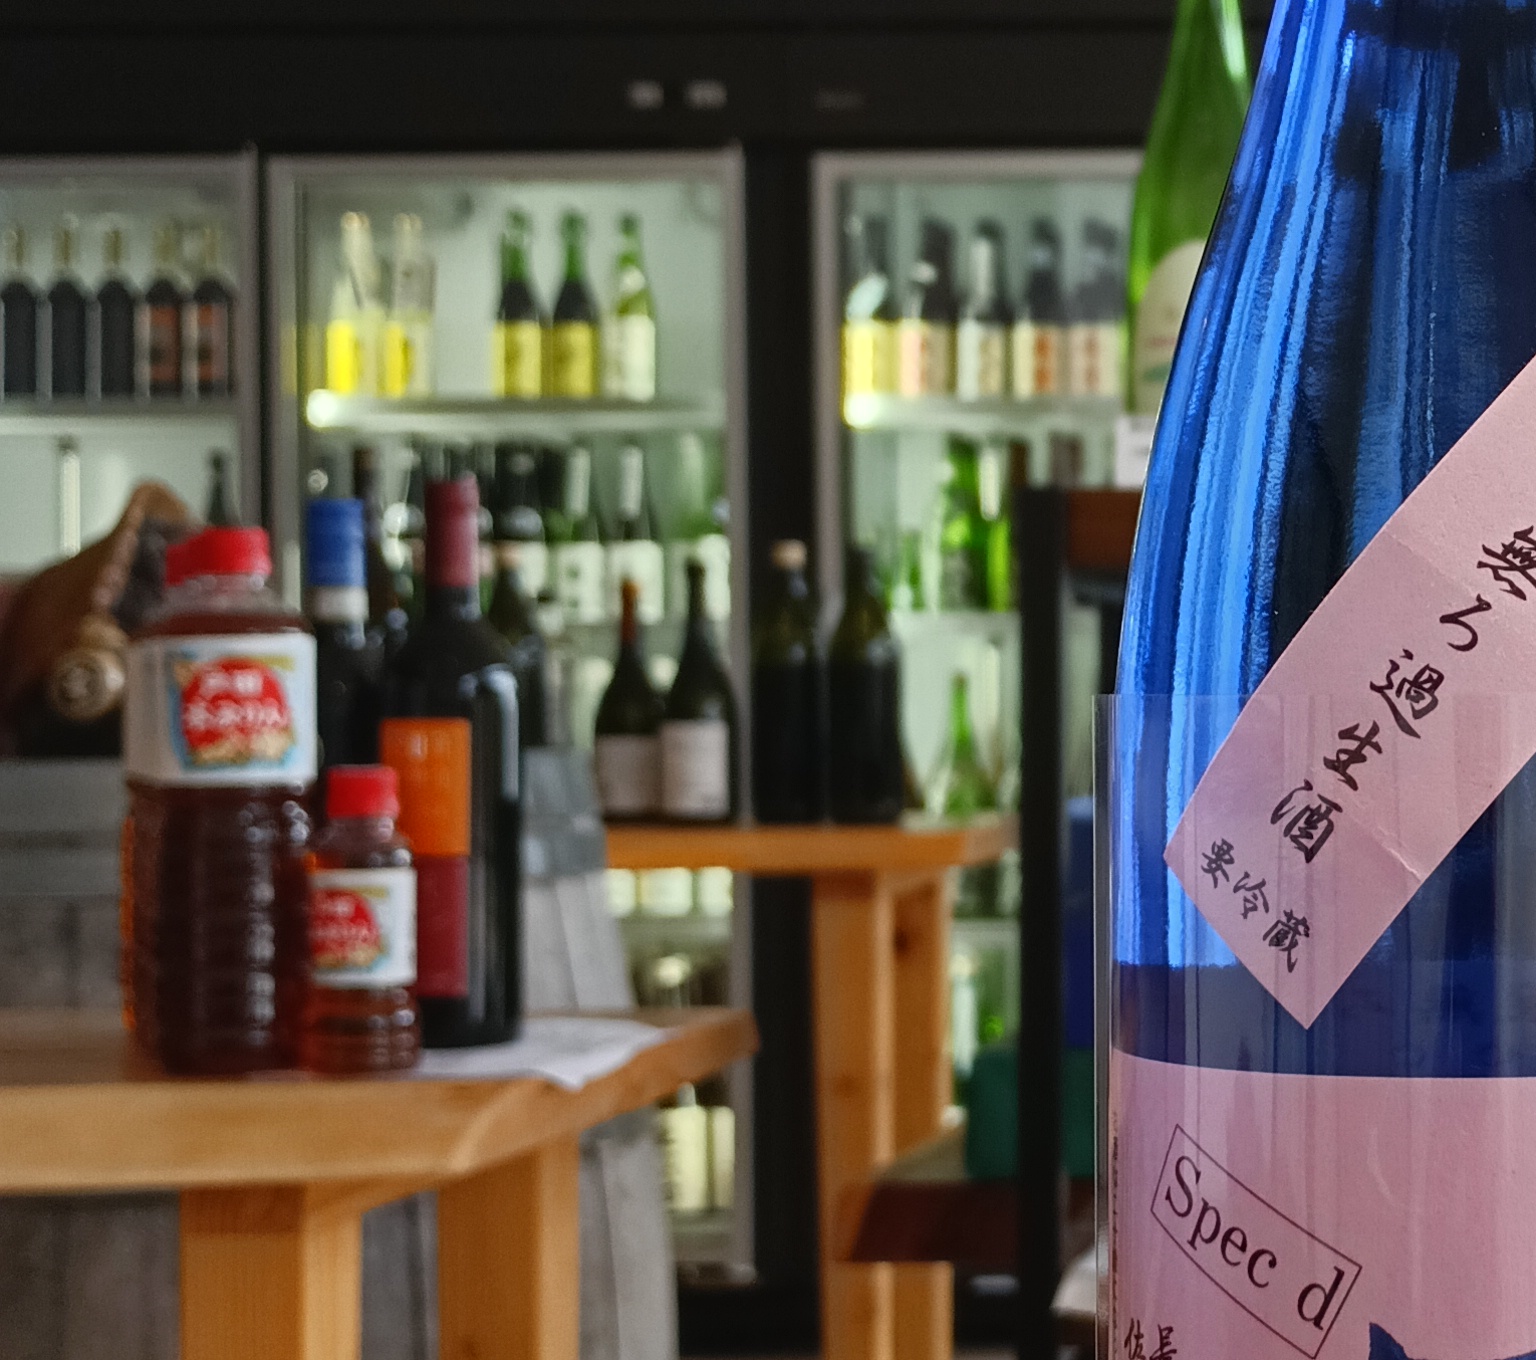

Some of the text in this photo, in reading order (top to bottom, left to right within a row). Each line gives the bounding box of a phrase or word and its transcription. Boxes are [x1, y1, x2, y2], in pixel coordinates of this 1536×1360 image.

[1201, 837, 1312, 974] 要冷蔵
[1164, 1154, 1346, 1332] Spec d
